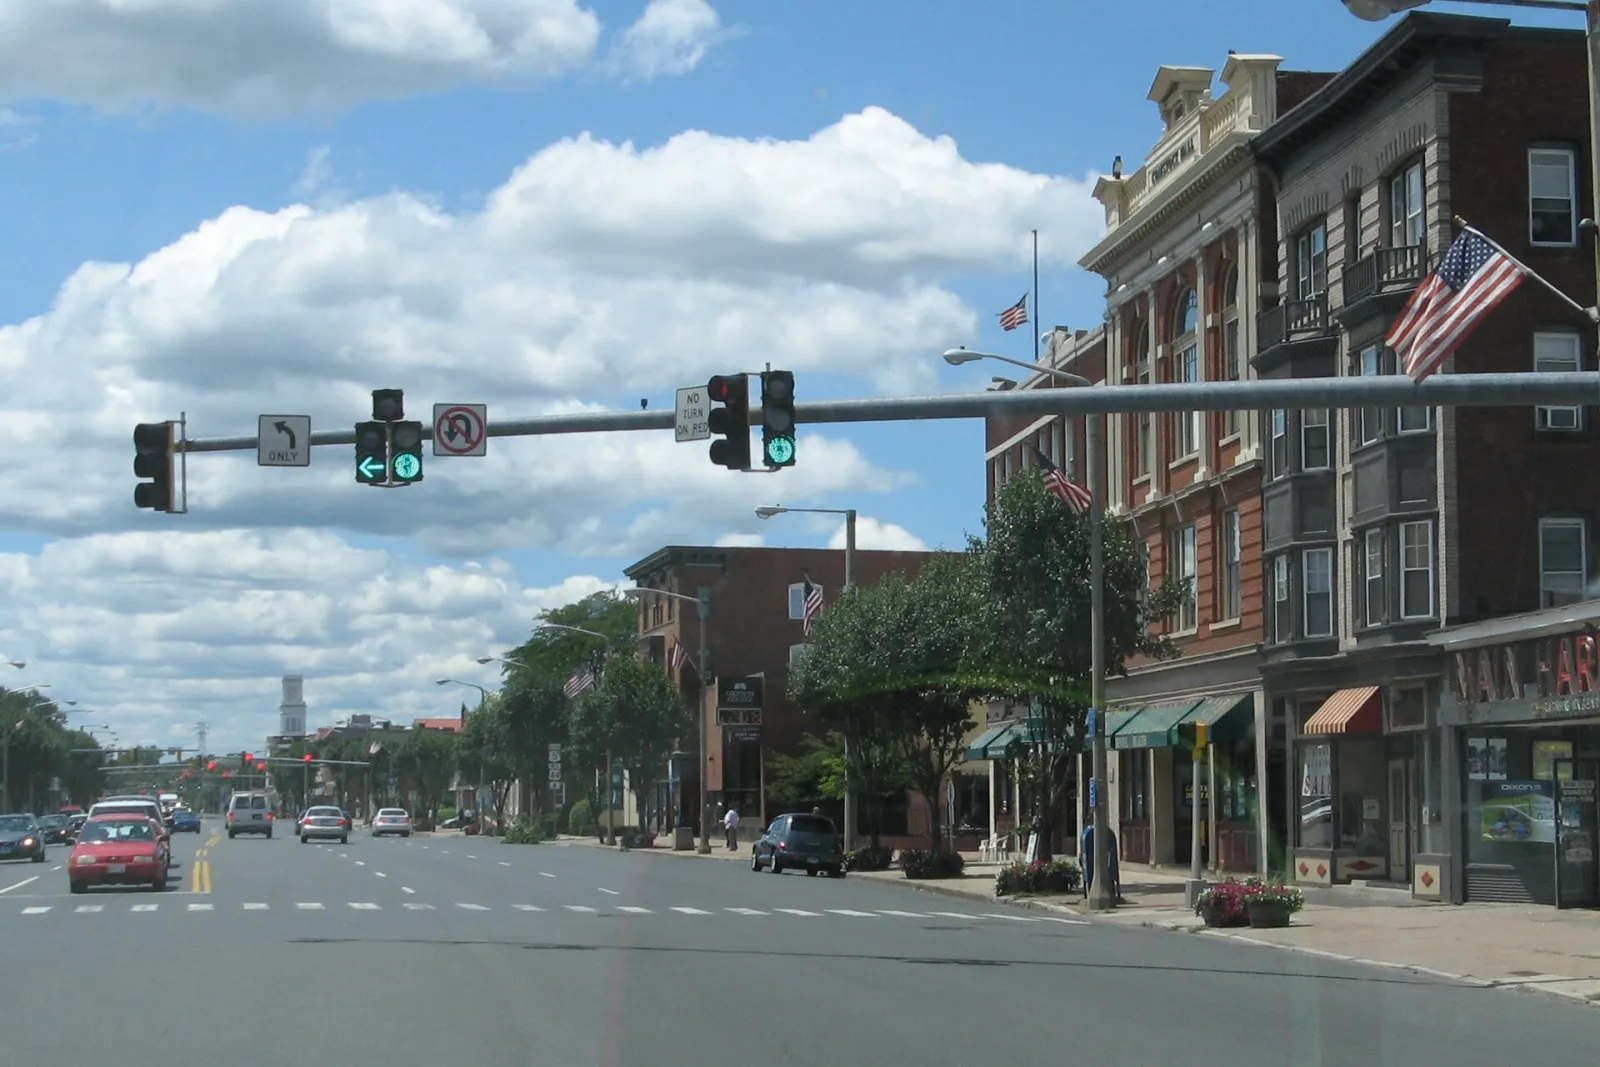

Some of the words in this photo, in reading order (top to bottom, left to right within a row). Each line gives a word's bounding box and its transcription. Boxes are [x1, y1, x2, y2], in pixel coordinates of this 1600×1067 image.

[687, 393, 700, 404] NO
[683, 408, 704, 419] TURN
[677, 424, 688, 435] ON
[692, 421, 709, 435] RED
[269, 451, 298, 462] ONLY
[1536, 634, 1600, 698] HAR
